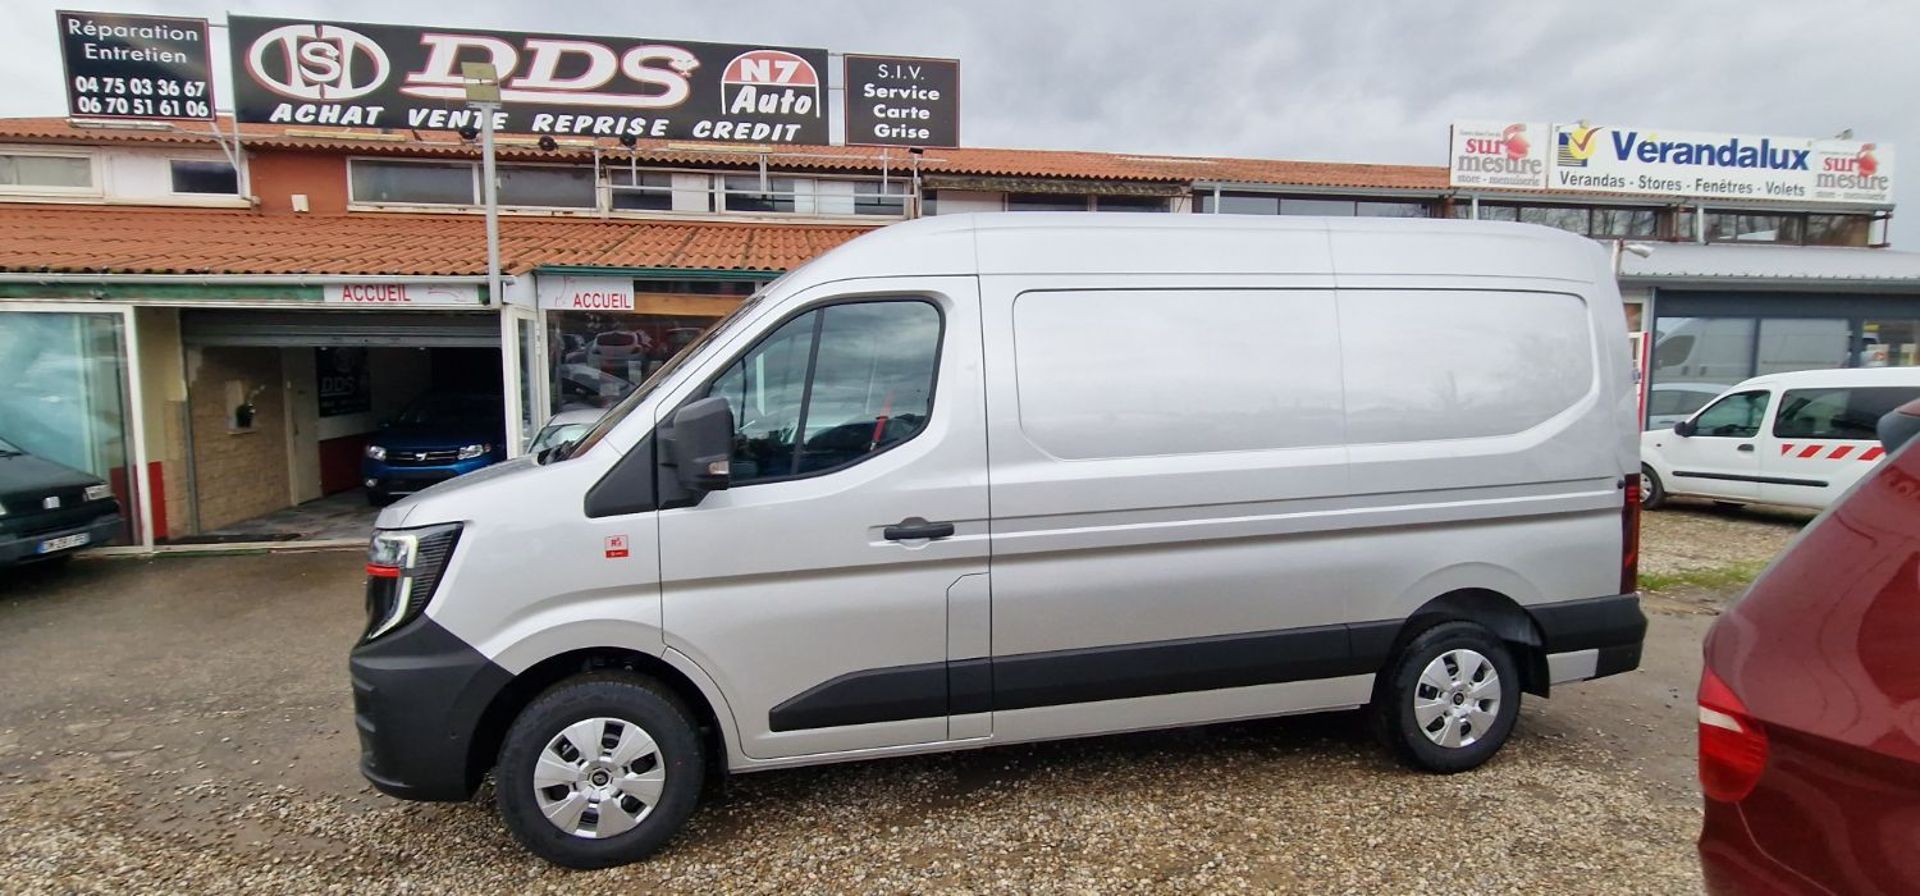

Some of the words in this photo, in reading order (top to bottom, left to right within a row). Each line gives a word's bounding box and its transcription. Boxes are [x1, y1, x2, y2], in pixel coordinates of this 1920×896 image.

[68, 18, 198, 42] Réparation
[84, 43, 187, 63] Entretien
[401, 32, 700, 107] DDS
[740, 58, 801, 83] N7
[878, 63, 925, 80] S.I.V.
[76, 76, 99, 93] 04
[103, 77, 126, 94] 75
[130, 78, 153, 95] 03
[157, 79, 180, 97] 36
[184, 81, 206, 97] 67
[863, 83, 941, 100] Service
[78, 96, 101, 113] 06
[105, 97, 129, 114] 70
[133, 99, 154, 115] 51
[159, 100, 180, 116] 61
[185, 101, 209, 117] 06
[730, 85, 813, 115] Auto
[873, 103, 931, 119] Carte
[269, 103, 385, 125] ACHAT
[408, 108, 509, 129] VENTE
[531, 113, 670, 136] REPRISE
[692, 120, 802, 141] CREDIT
[874, 123, 930, 139] Grise
[1465, 137, 1509, 155] sur
[1458, 154, 1542, 175] mesure
[1638, 174, 1683, 192] Stores
[1695, 177, 1754, 194] Fenêtres
[1766, 182, 1806, 197] Volets
[1816, 172, 1889, 190] mesure
[342, 284, 412, 302] ACCUEIL
[573, 292, 632, 309] ACCUEIL
